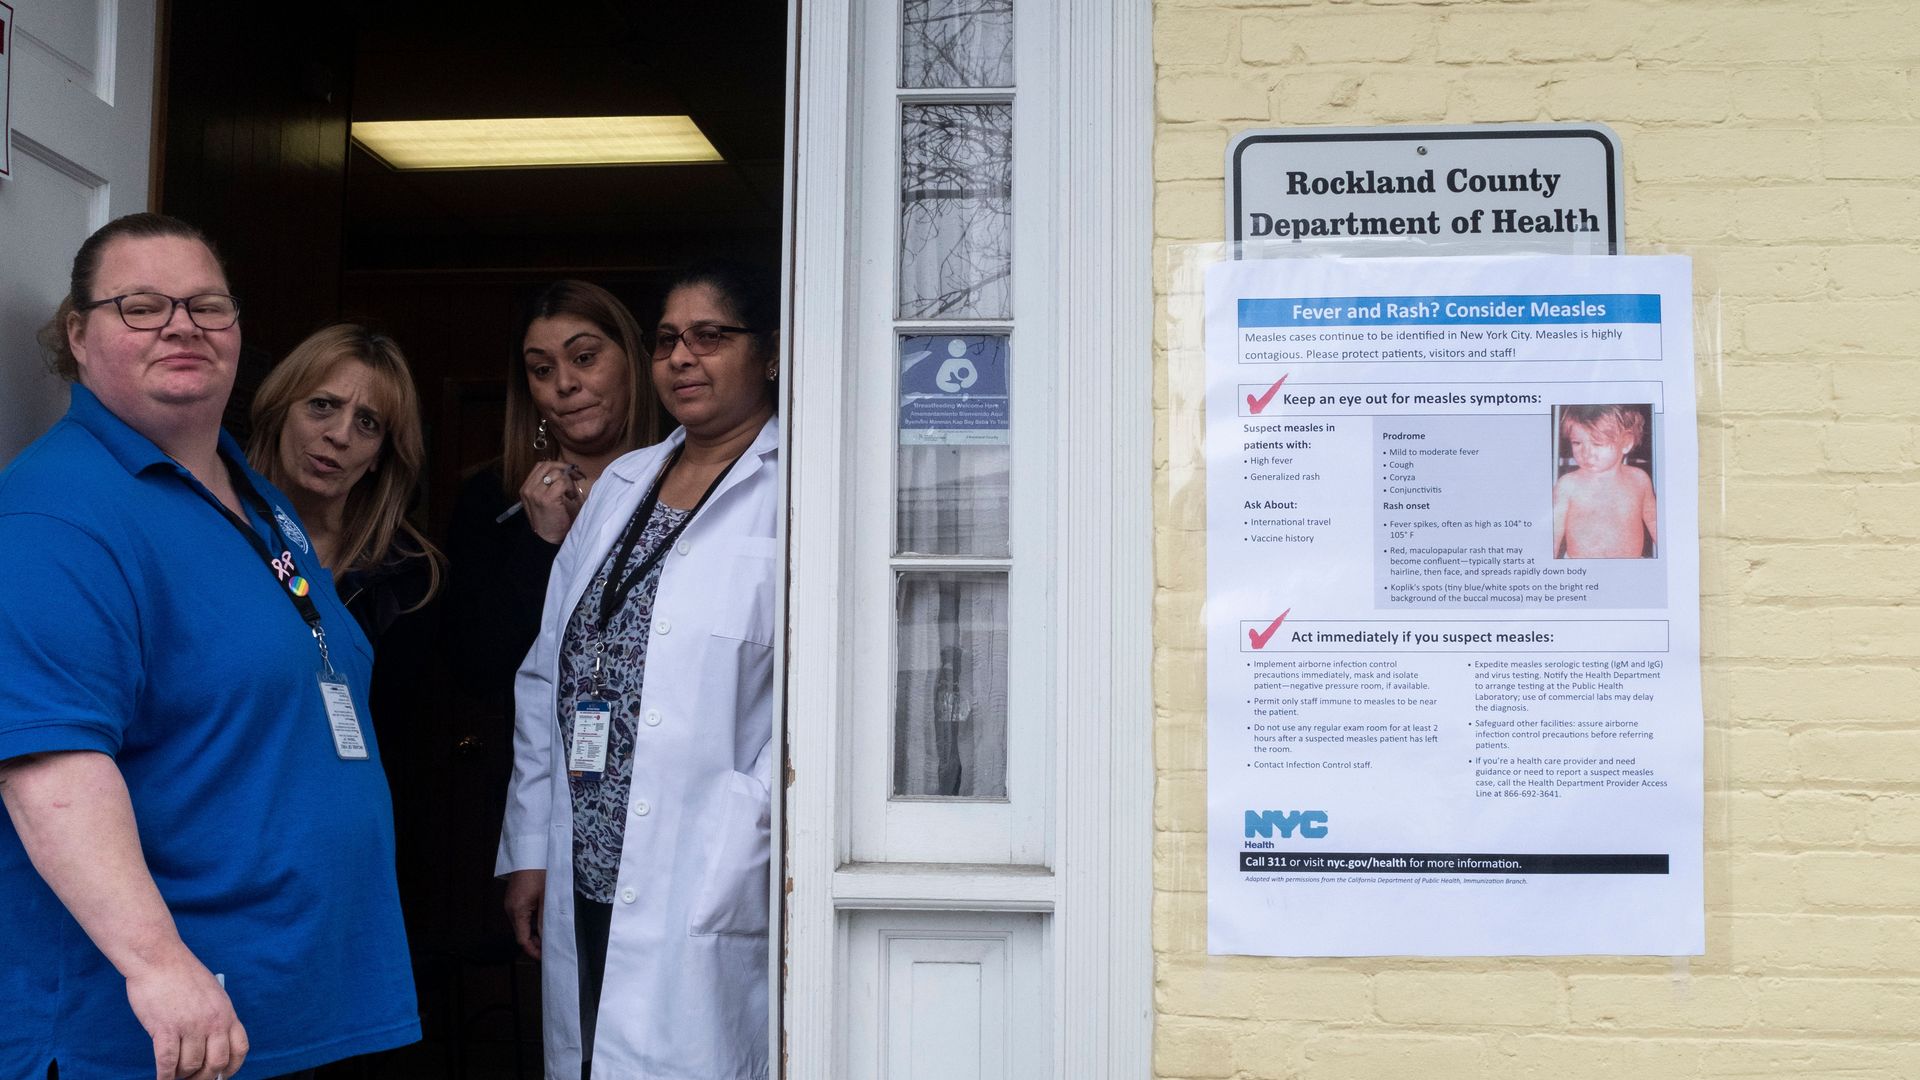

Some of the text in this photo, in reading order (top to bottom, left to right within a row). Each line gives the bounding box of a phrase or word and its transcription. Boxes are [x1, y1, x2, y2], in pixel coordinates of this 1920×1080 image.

[1286, 168, 1561, 198] Rockland County
[1250, 209, 1600, 242] Department of Health
[1294, 302, 1606, 319] Fever and Rash? Consider Measles
[1246, 333, 1286, 341] Measles
[1320, 332, 1364, 341] continue
[1381, 331, 1393, 340] be
[1396, 330, 1444, 340] identified
[1448, 331, 1457, 339] in
[1461, 331, 1483, 339] New
[1486, 330, 1508, 339] York
[1511, 330, 1532, 341] City.
[1536, 330, 1578, 339] Measles
[1581, 330, 1588, 339] is
[1592, 330, 1622, 340] highly
[1246, 348, 1515, 360] contagious. Please protect patients, visitors and staff!
[1284, 393, 1541, 407] Keep an eye out for measles symptoms:
[1244, 424, 1335, 434] Suspect measles in
[1244, 440, 1311, 451] patients with:
[1251, 456, 1293, 466] High fever
[1390, 460, 1414, 469] Cough
[1390, 474, 1416, 482] Coryza
[1390, 486, 1442, 495] Conjunctivitis
[1244, 500, 1297, 509] Ask About:
[1251, 518, 1305, 527] International
[1414, 521, 1439, 529] spikes,
[1475, 520, 1491, 529] high
[1286, 534, 1314, 544] history
[1390, 546, 1407, 555] Red,
[1410, 546, 1467, 555] maculopapular
[1444, 568, 1462, 576] face,
[1481, 568, 1512, 576] spreads
[1514, 568, 1540, 576] rapidly
[1422, 585, 1442, 593] spots
[1445, 584, 1462, 592] (tiny
[1464, 584, 1507, 592] blue/white
[1560, 584, 1583, 592] bright
[1391, 594, 1436, 602] background
[1490, 595, 1523, 603] mucosa)
[1292, 631, 1554, 645] Act immediately if you suspect measles:
[1254, 661, 1296, 669] Implement
[1475, 661, 1508, 670] Expedite
[1545, 661, 1580, 670] serologic
[1582, 661, 1609, 669] testing
[1611, 660, 1628, 669] (IgM
[1648, 660, 1663, 669] IgG)
[1475, 720, 1514, 728] Safeguard
[1245, 810, 1328, 839] NYC
[1246, 857, 1264, 866] Call
[1268, 857, 1287, 866] 311
[1304, 858, 1324, 867] visit
[1328, 857, 1406, 869] nyc.gov/health
[1410, 858, 1424, 868] for
[1458, 858, 1522, 868] information.
